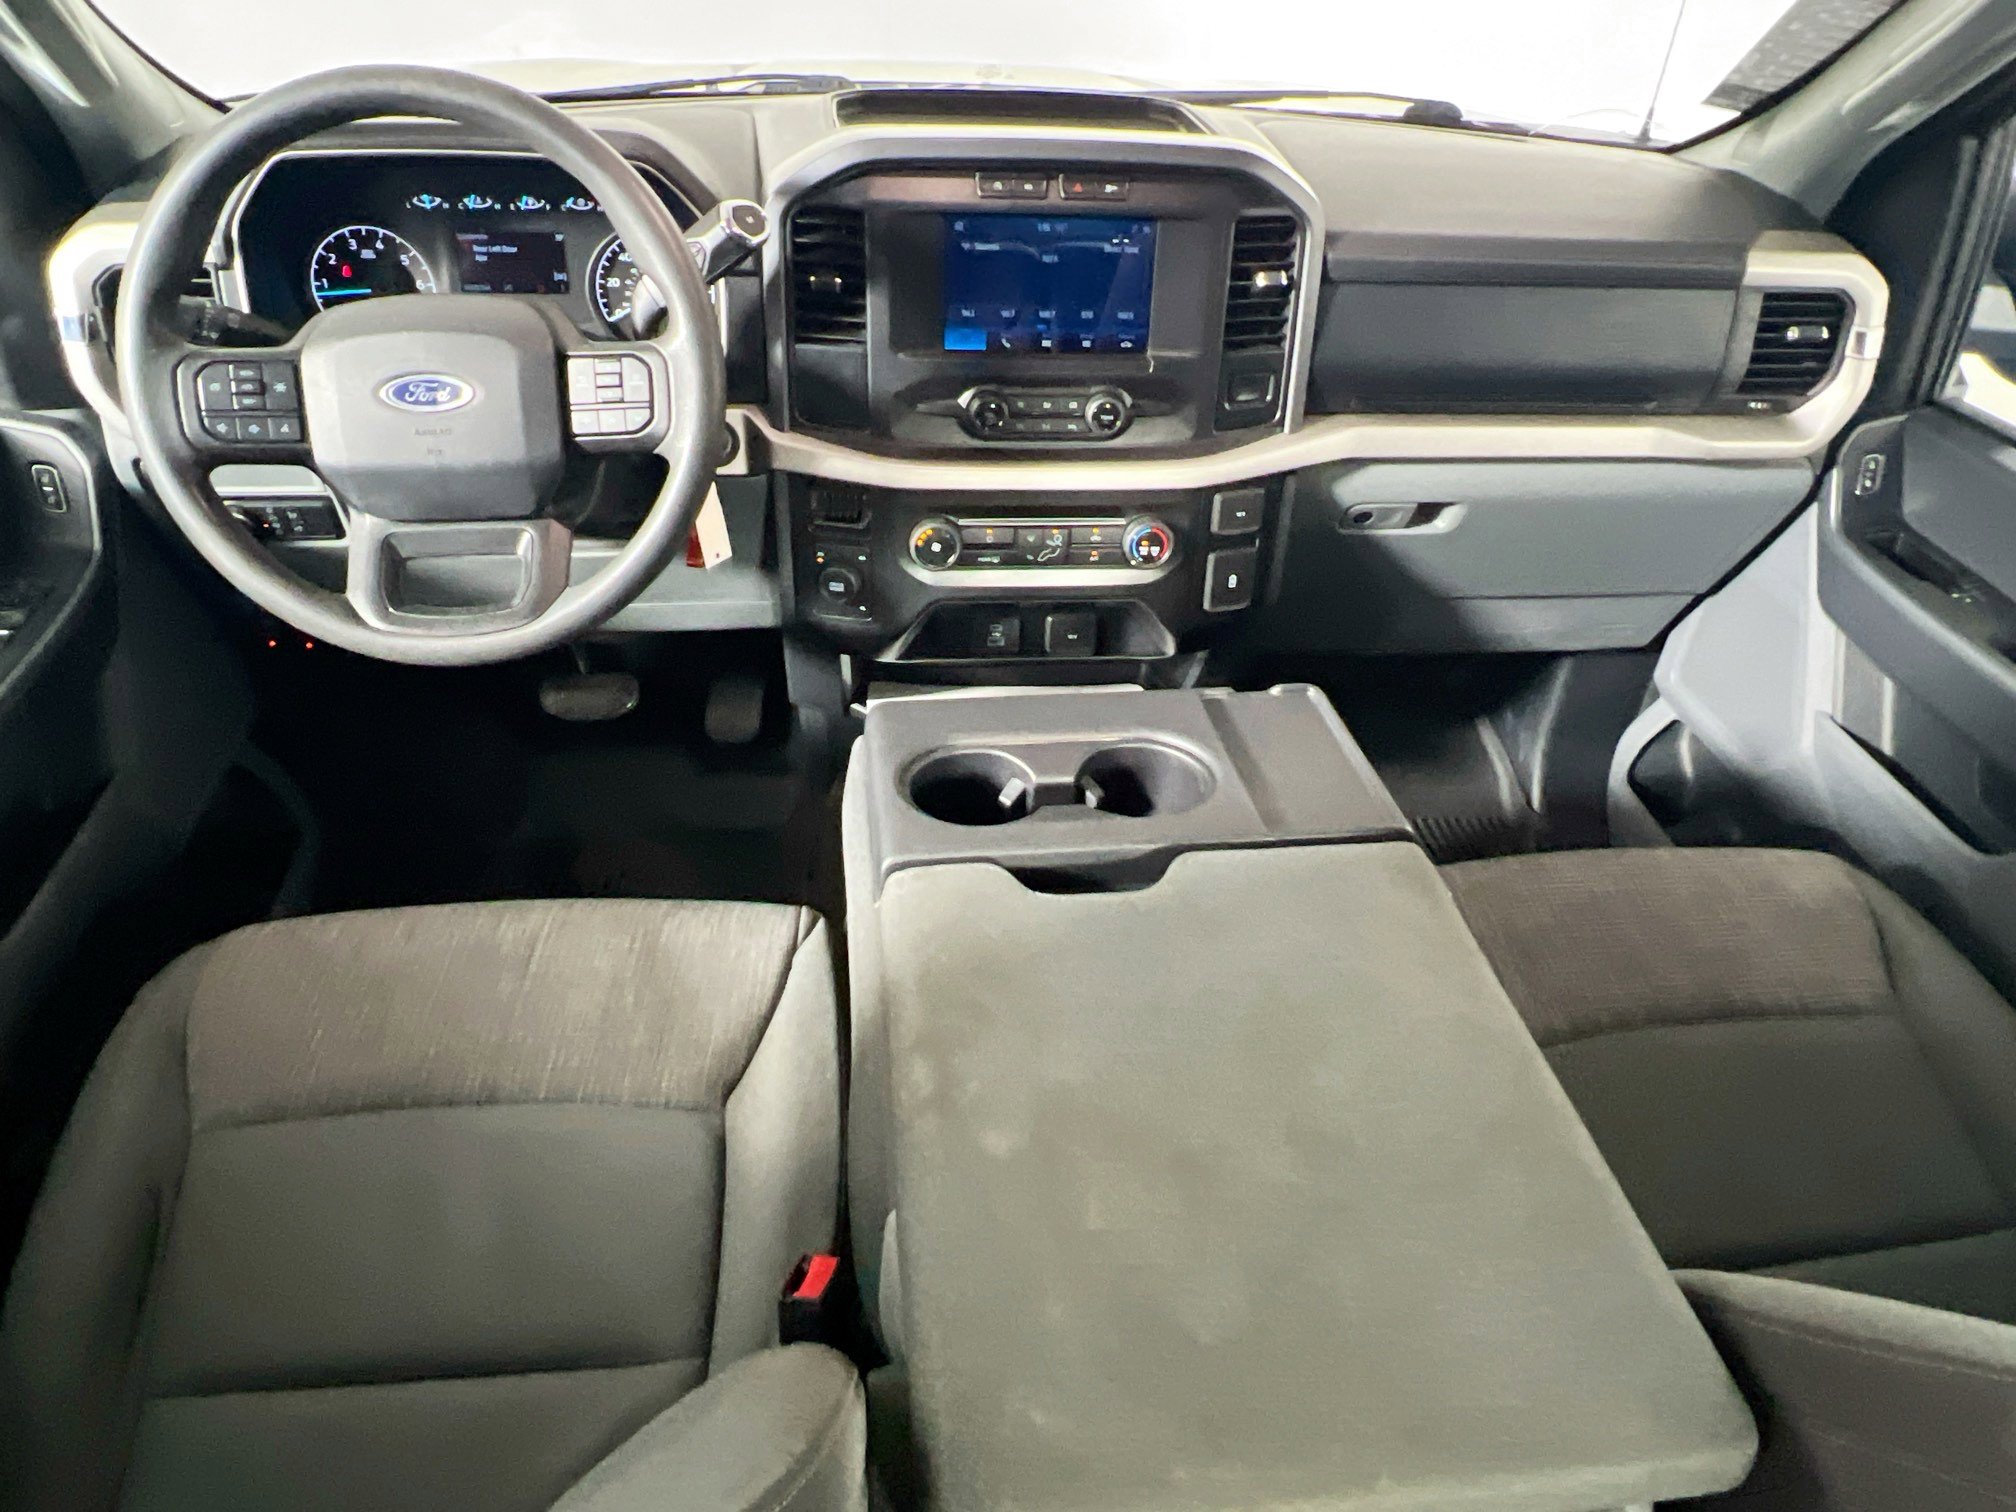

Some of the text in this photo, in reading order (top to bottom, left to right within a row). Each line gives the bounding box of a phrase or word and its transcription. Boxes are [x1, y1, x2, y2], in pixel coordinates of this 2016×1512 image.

[347, 239, 358, 251] 3
[375, 239, 385, 250] 4
[327, 253, 338, 265] 2
[400, 254, 410, 266] 5
[321, 278, 329, 289] 1
[415, 280, 425, 291] 6
[606, 277, 621, 288] 20
[404, 382, 452, 402] Ford
